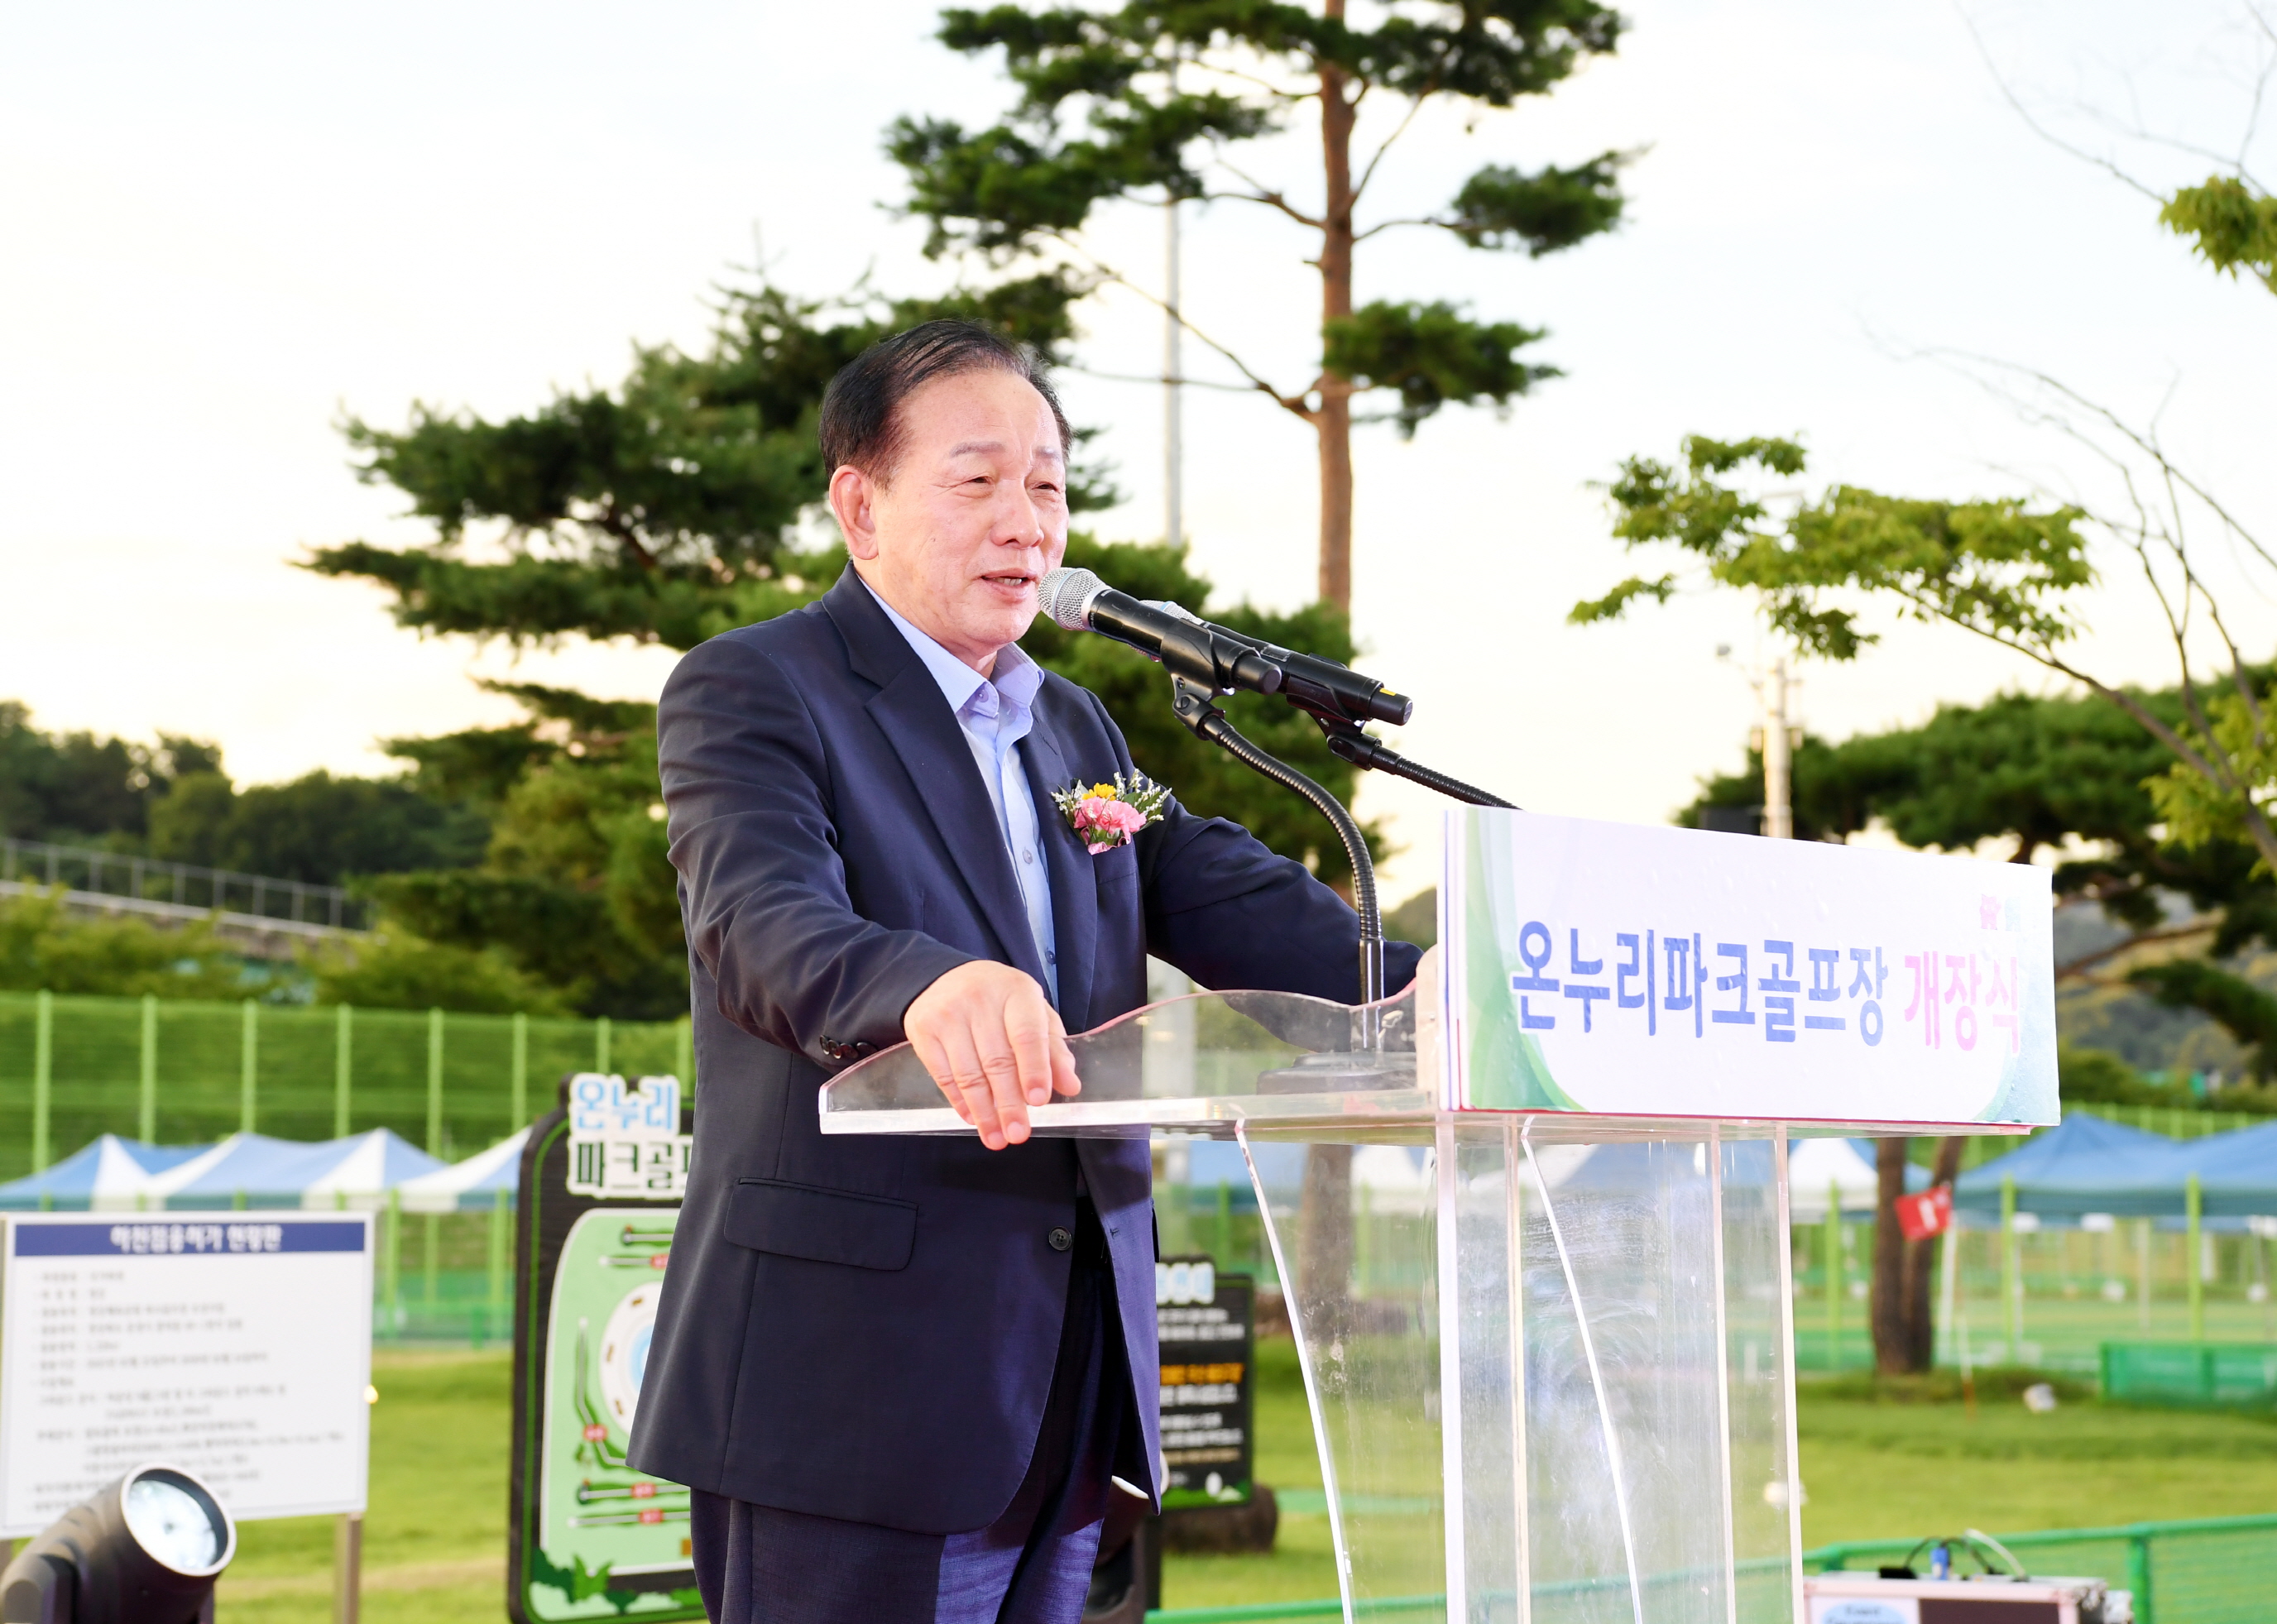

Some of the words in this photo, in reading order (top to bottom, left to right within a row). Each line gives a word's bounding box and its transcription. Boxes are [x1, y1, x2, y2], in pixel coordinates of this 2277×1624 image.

[1512, 920, 1888, 1047] 온누리파크골프장
[1904, 951, 2021, 1054] 개장식
[578, 1080, 674, 1131] 온누리
